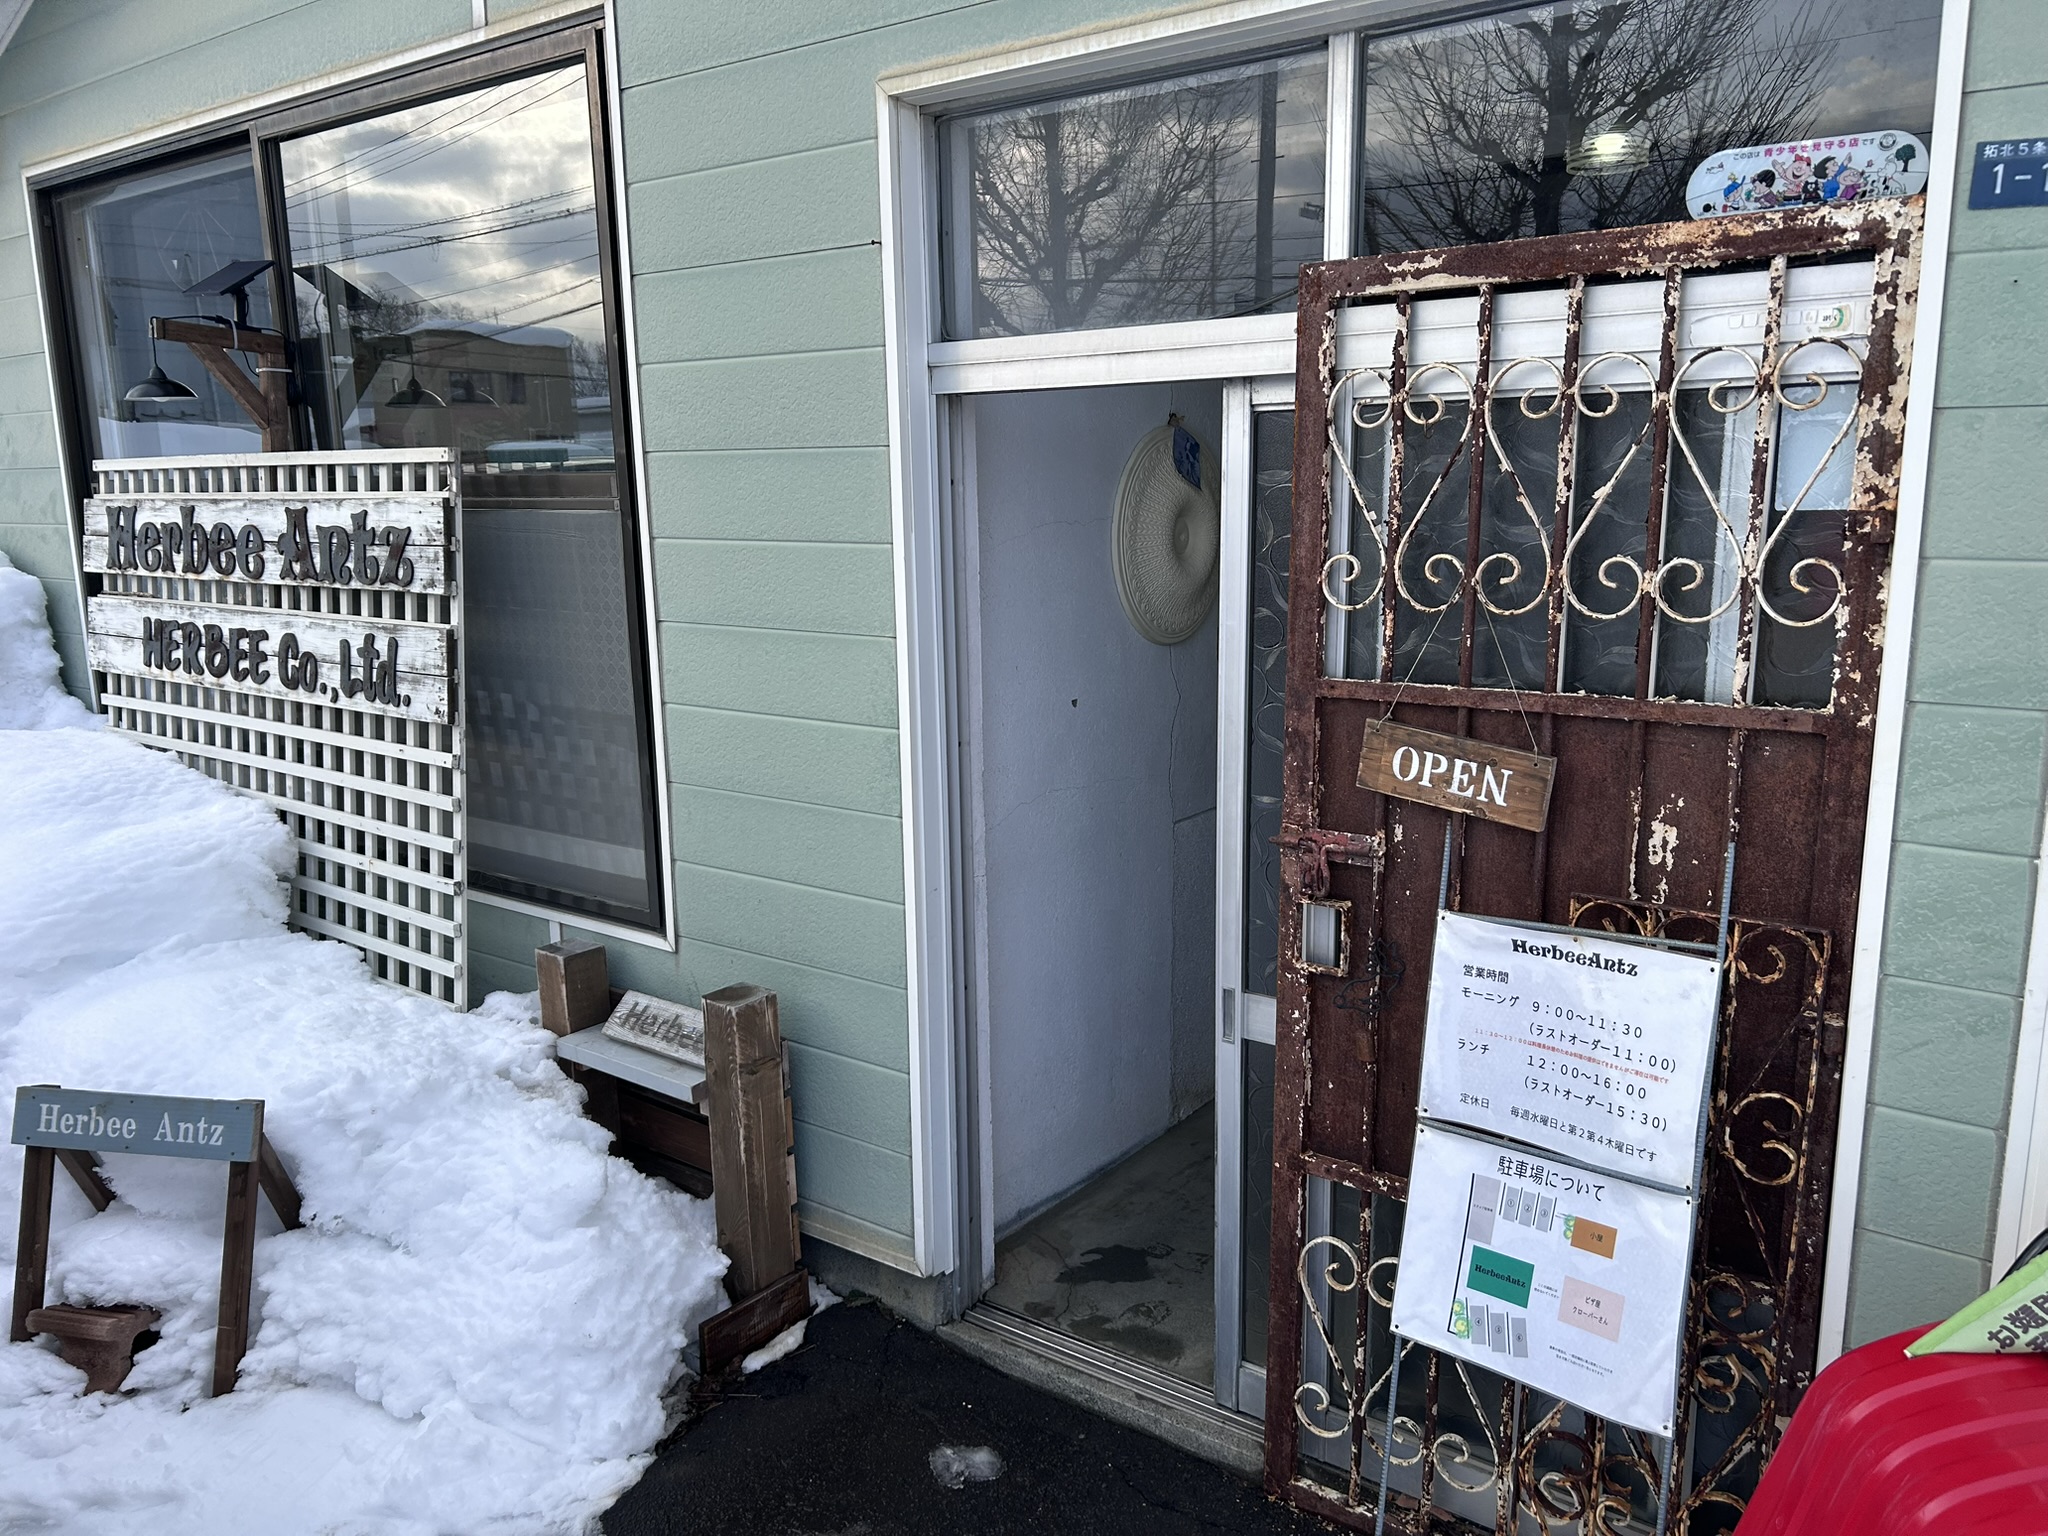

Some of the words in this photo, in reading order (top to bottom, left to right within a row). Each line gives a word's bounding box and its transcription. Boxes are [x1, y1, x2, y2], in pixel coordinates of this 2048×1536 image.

[105, 504, 265, 580] Herbee
[277, 506, 415, 587] Antz
[142, 616, 270, 684] HERBEE
[1392, 746, 1513, 807] OPEN
[1462, 964, 1510, 984] 営業時間
[1510, 938, 1639, 977] HerbeeAntz
[1461, 986, 1520, 1008] モーニング
[1457, 1038, 1490, 1055] ランチ
[37, 1103, 136, 1139] Herbee
[153, 1112, 225, 1146] Antz
[1459, 1092, 1490, 1109] 定休日
[1510, 1105, 1658, 1162] 毎週水曜日と第2第4木曜日です
[1497, 1155, 1606, 1202] 駐車場について
